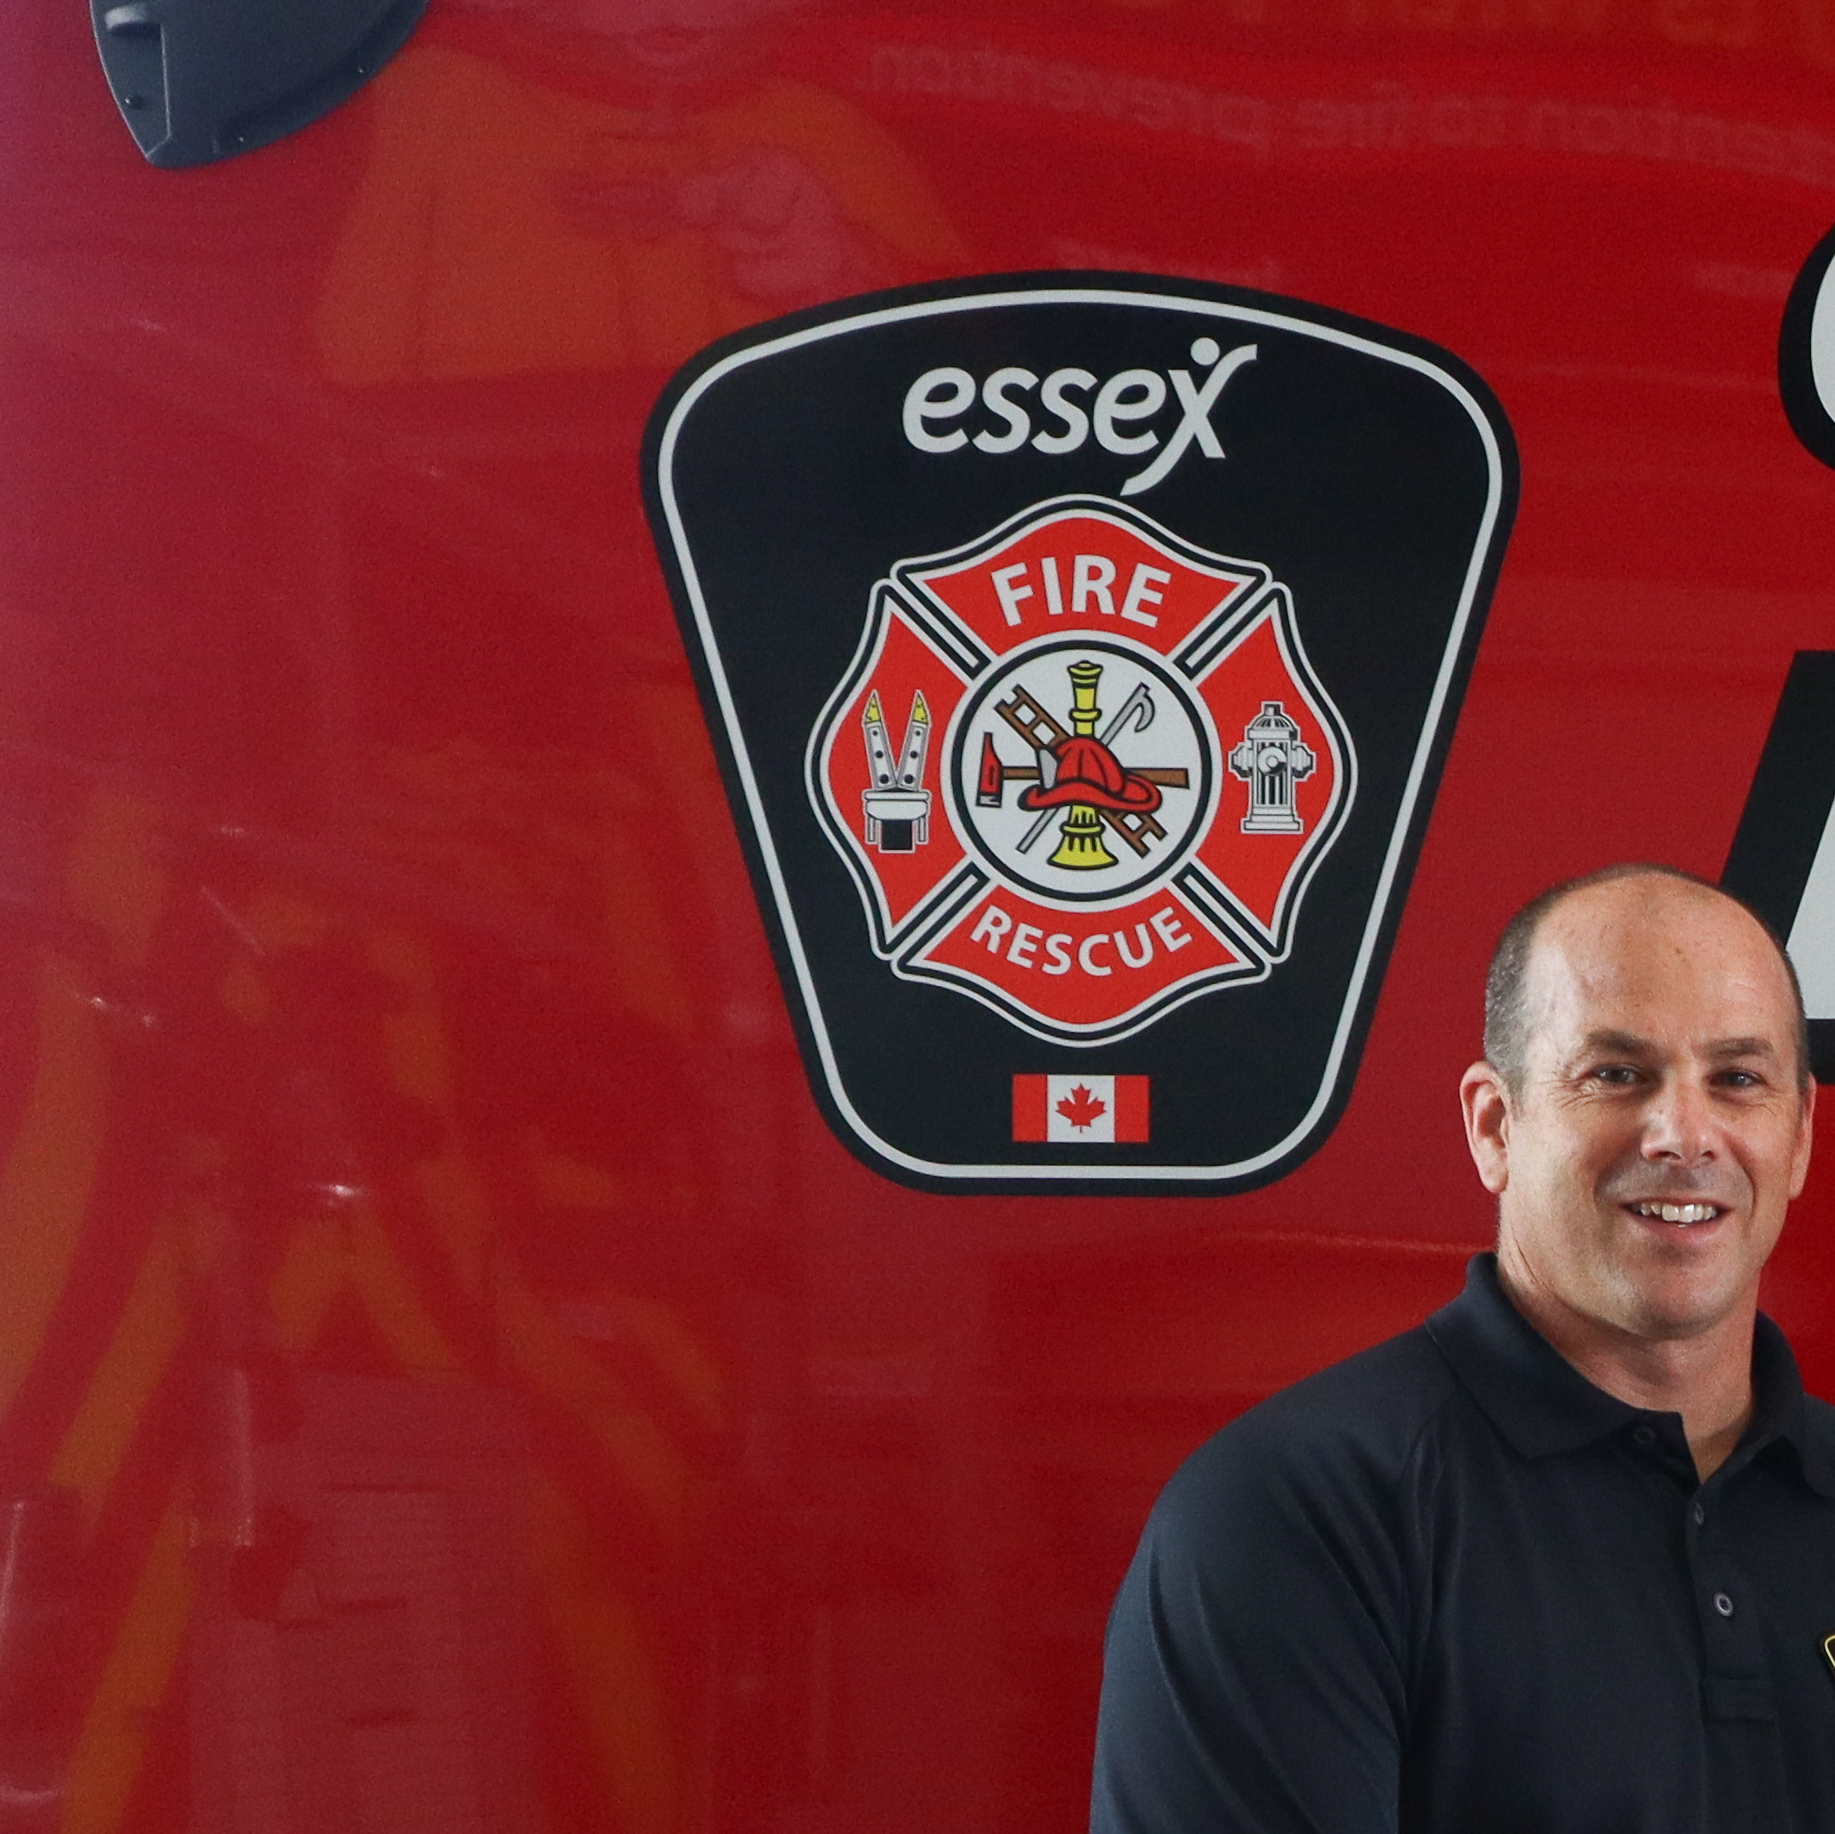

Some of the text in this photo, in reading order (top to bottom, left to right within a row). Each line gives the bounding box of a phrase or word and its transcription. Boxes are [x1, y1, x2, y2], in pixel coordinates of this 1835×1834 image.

[902, 337, 1258, 496] essex
[989, 553, 1173, 628] FIRE
[969, 905, 1193, 978] RESCUE
